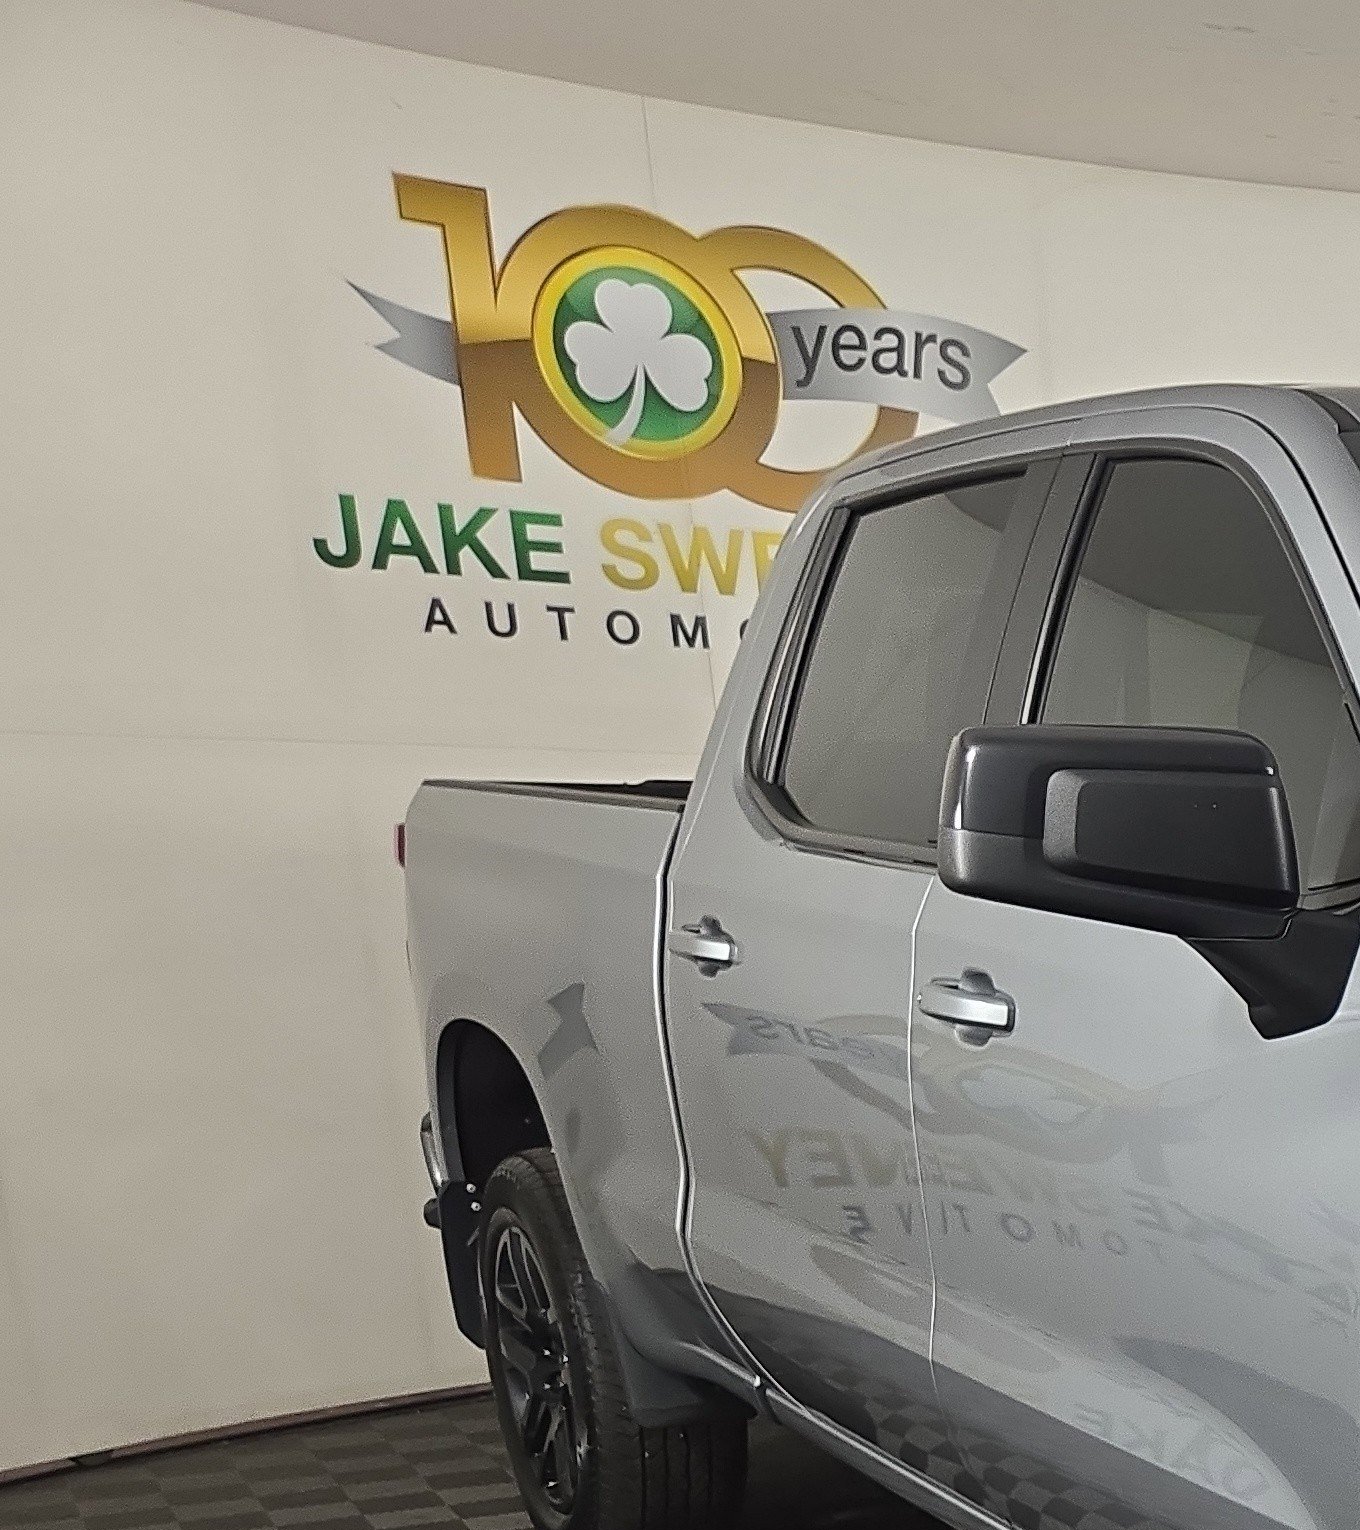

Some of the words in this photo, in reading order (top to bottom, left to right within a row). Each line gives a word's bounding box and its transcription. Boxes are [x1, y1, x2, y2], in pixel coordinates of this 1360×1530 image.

[393, 172, 918, 514] 100
[789, 318, 973, 392] years
[312, 494, 571, 586] JAKE
[423, 597, 750, 650] AUTOM
